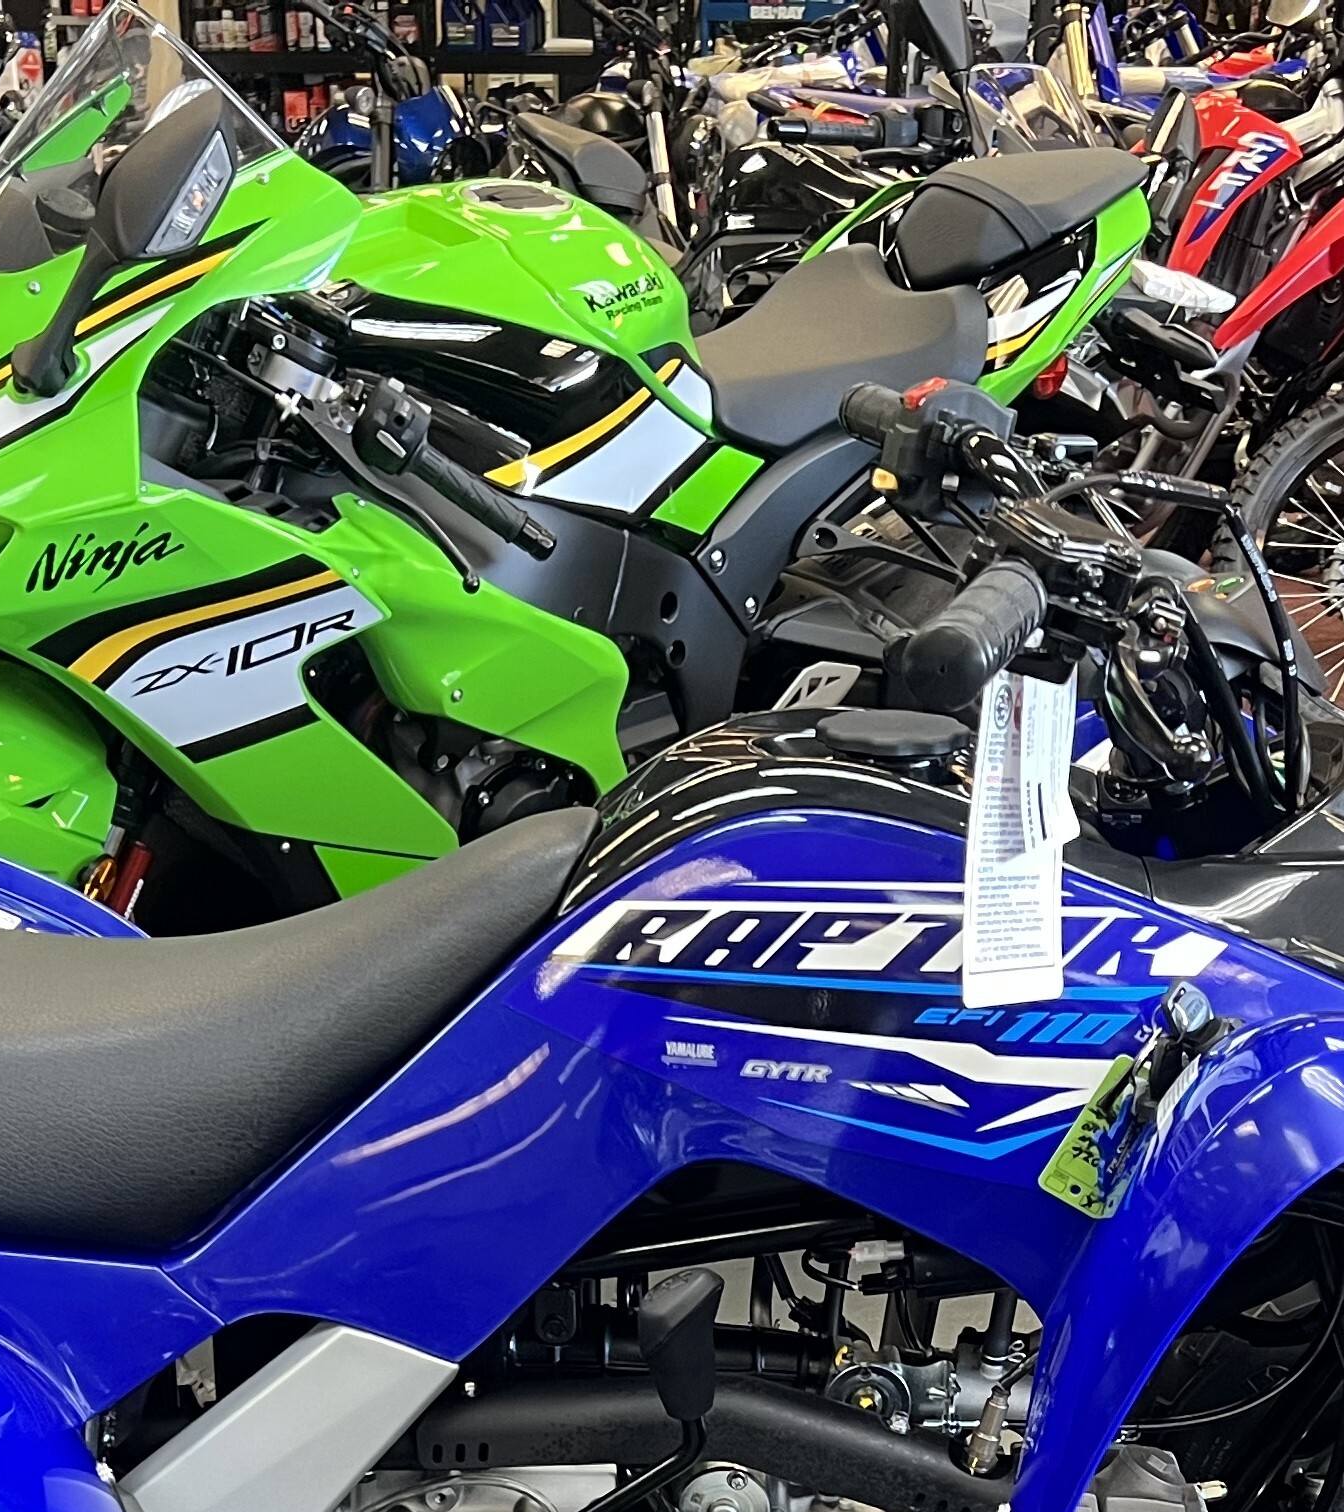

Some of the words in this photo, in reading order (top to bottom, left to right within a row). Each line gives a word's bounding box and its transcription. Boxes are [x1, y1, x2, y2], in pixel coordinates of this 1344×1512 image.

[24, 522, 184, 595] Ninja
[130, 608, 356, 698] ZX-10R
[554, 901, 1221, 980] RAPTR
[665, 1041, 716, 1061] YAMALUBE
[912, 1006, 1010, 1028] EFI
[996, 1010, 1139, 1046] 110
[738, 1059, 833, 1085] GYTR
